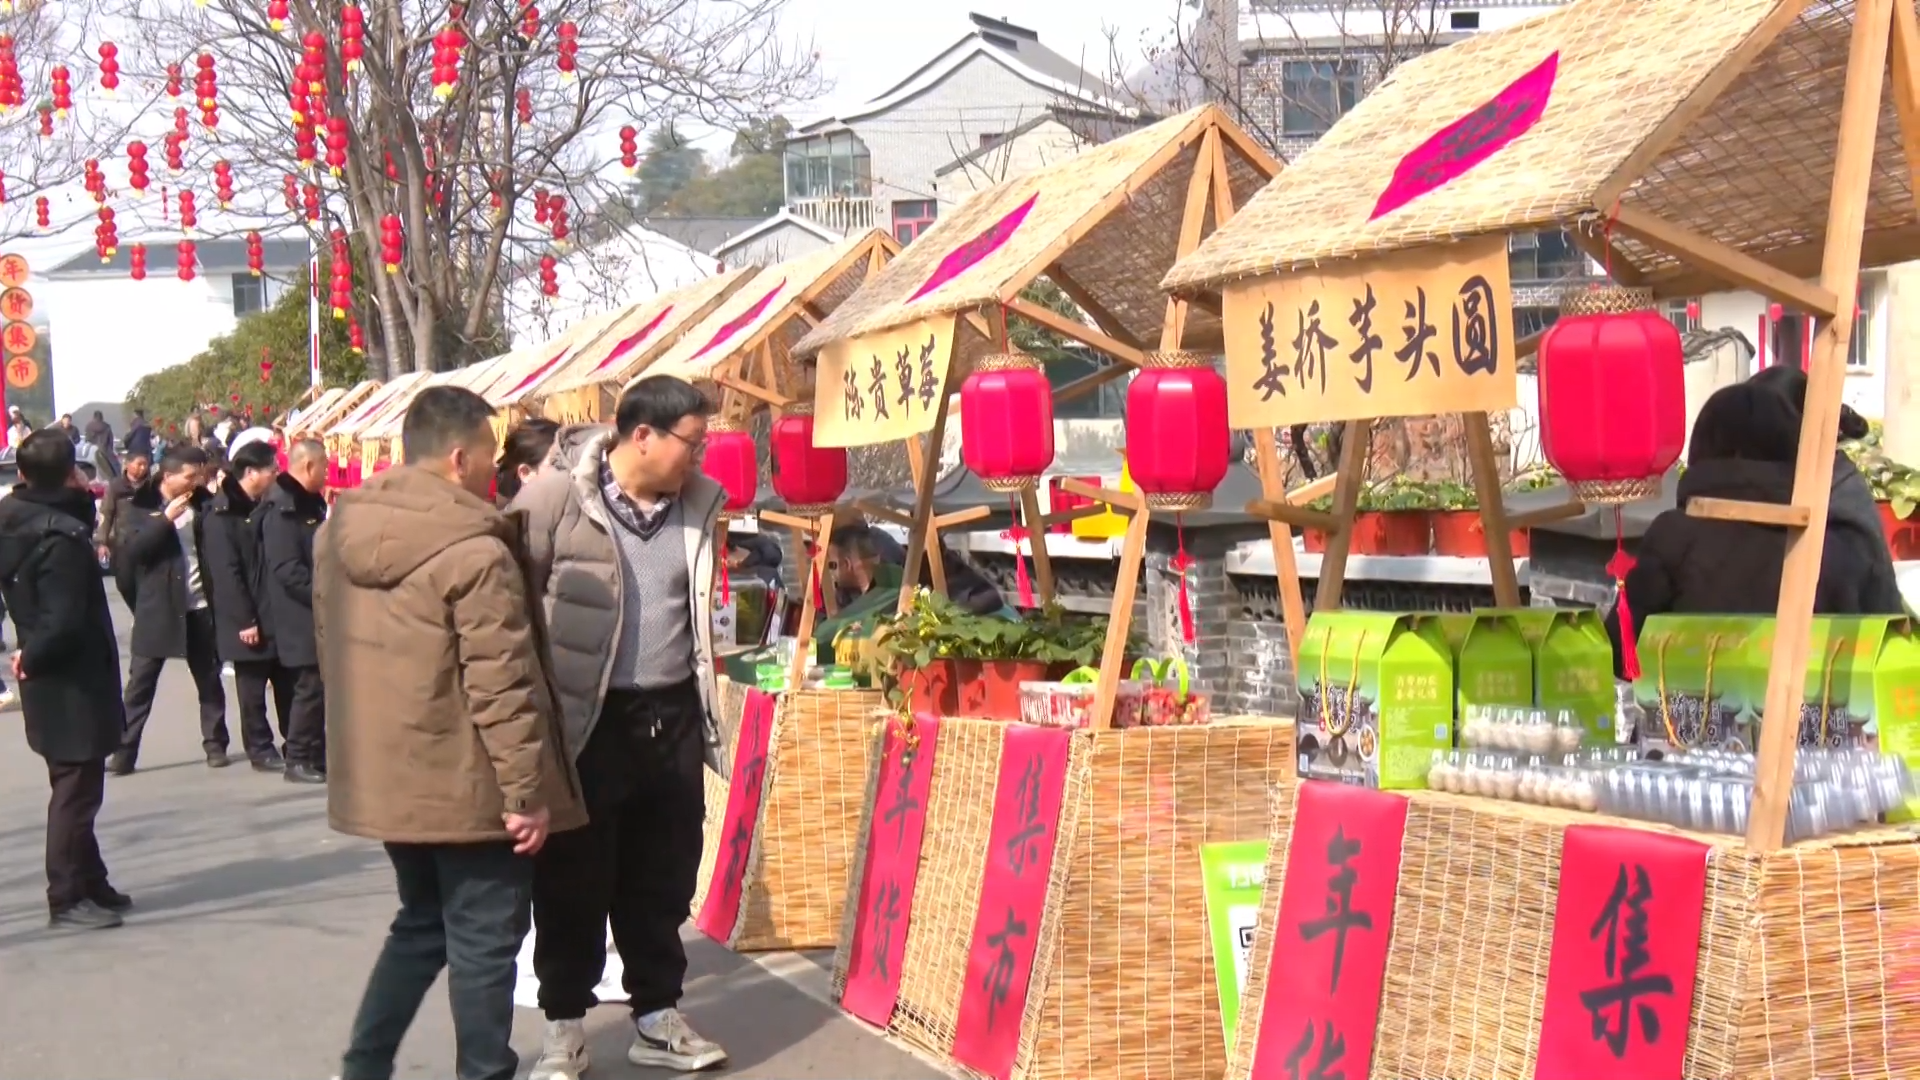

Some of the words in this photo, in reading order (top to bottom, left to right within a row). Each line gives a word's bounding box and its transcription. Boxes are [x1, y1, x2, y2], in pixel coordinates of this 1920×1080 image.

[3, 258, 31, 382] 年货集市
[1252, 274, 1498, 402] 姜桥芋头圆
[870, 747, 919, 985] 年货
[981, 751, 1047, 1036] 集市
[1579, 862, 1675, 1058] 集
